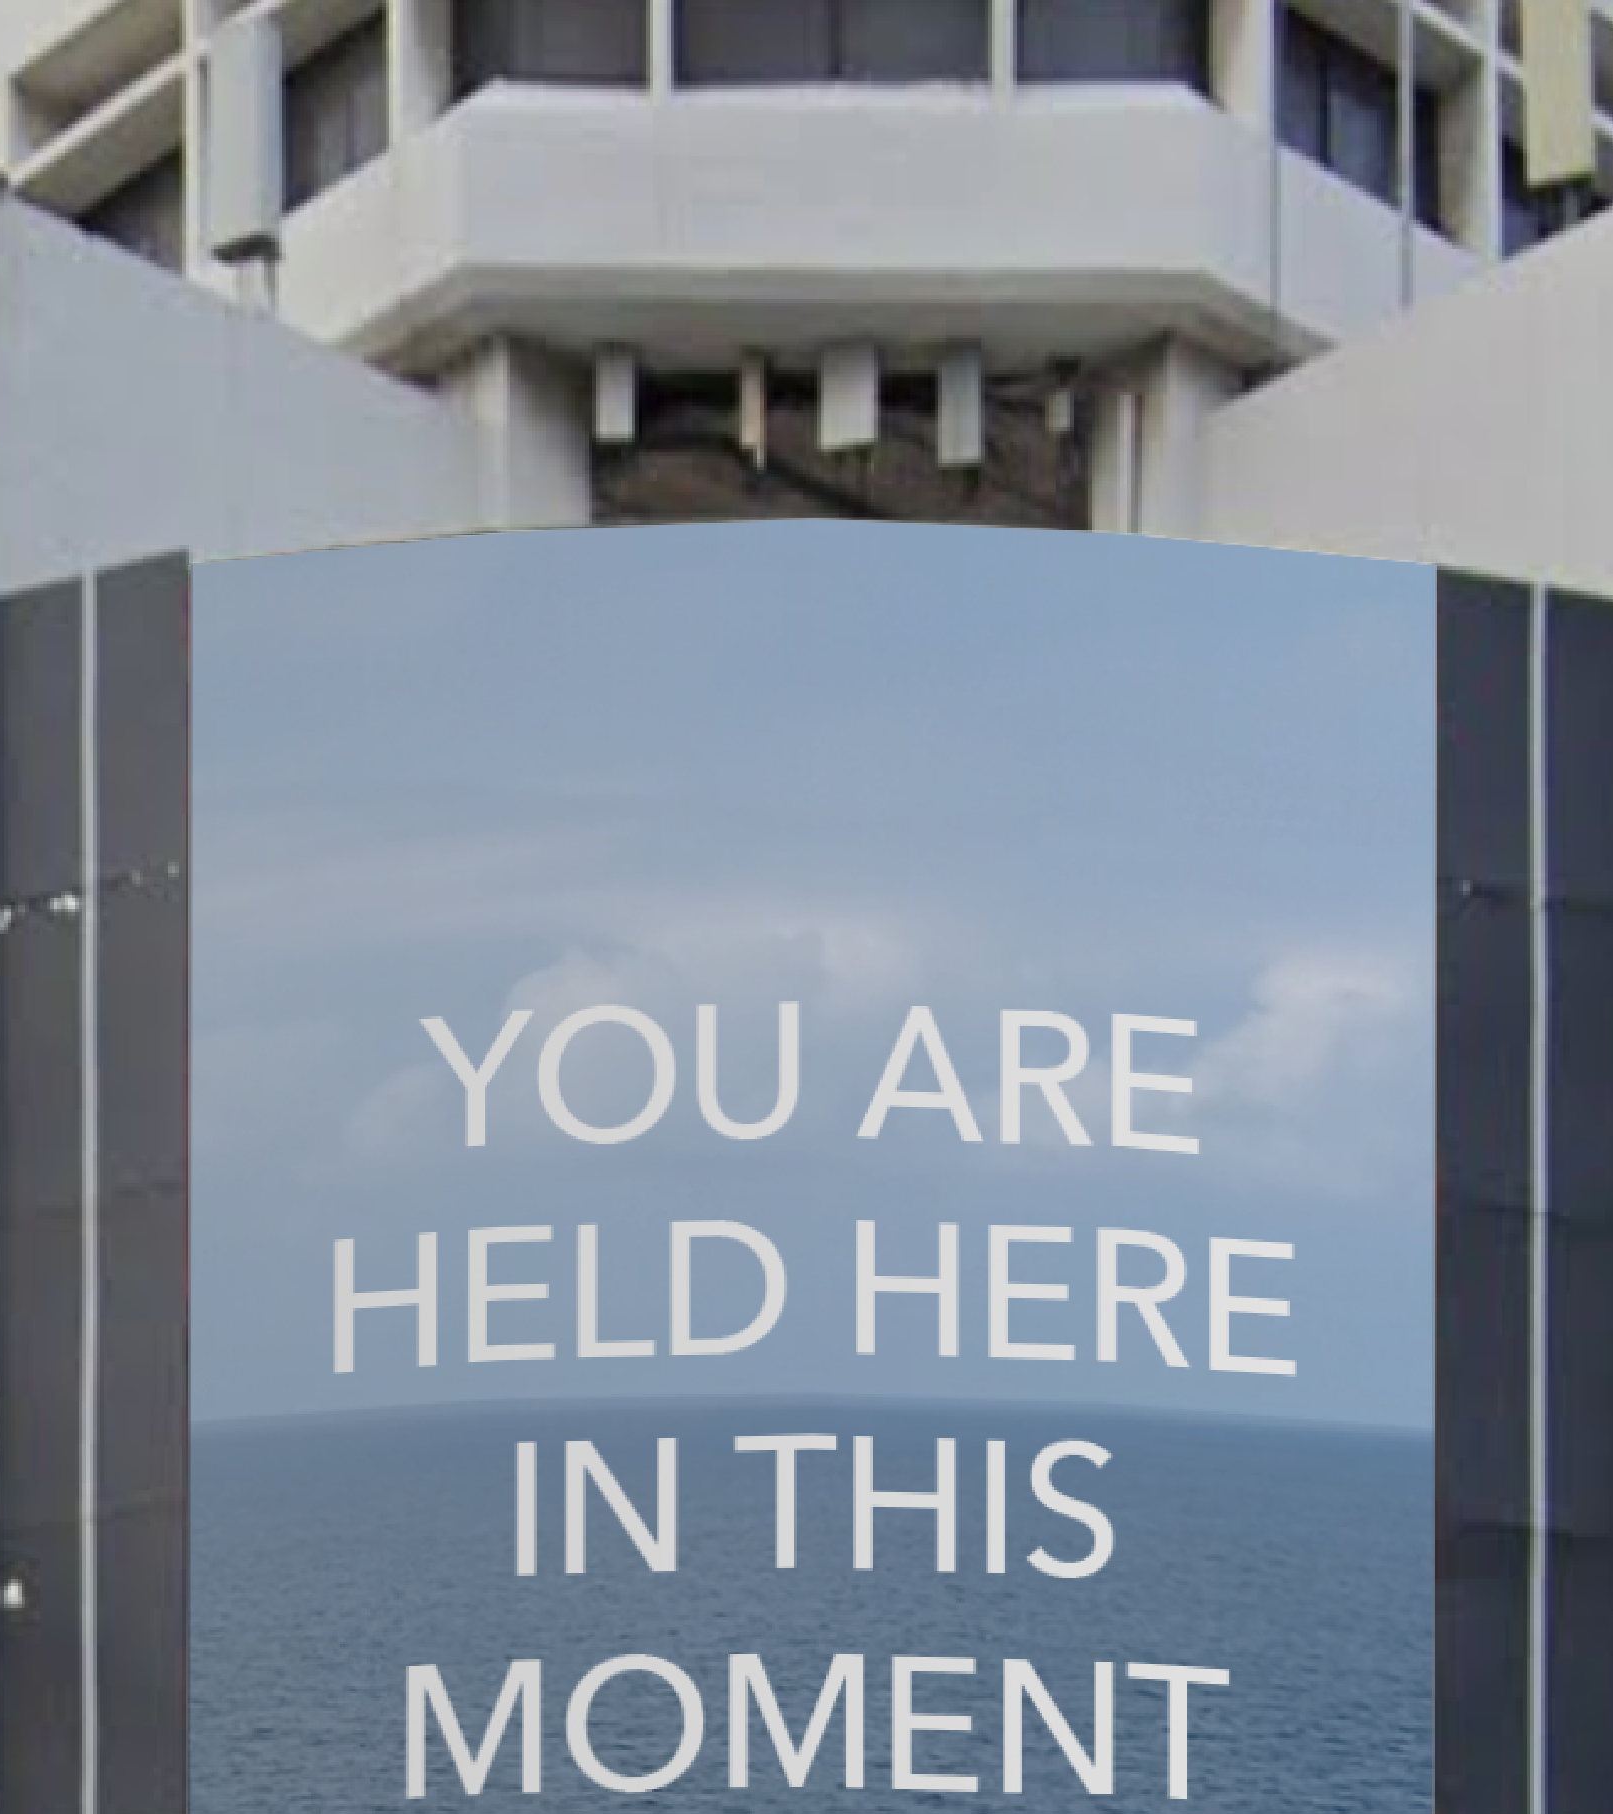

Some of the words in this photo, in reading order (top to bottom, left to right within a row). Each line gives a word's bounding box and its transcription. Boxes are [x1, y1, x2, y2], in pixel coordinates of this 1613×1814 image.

[421, 1001, 799, 1148] YOU
[857, 1005, 1200, 1155] ARE
[334, 1220, 786, 1373] HELD
[856, 1219, 1297, 1376] HERE
[516, 1437, 677, 1576] IN
[734, 1434, 1114, 1579] THIS
[405, 1653, 1230, 1801] MOMENT
